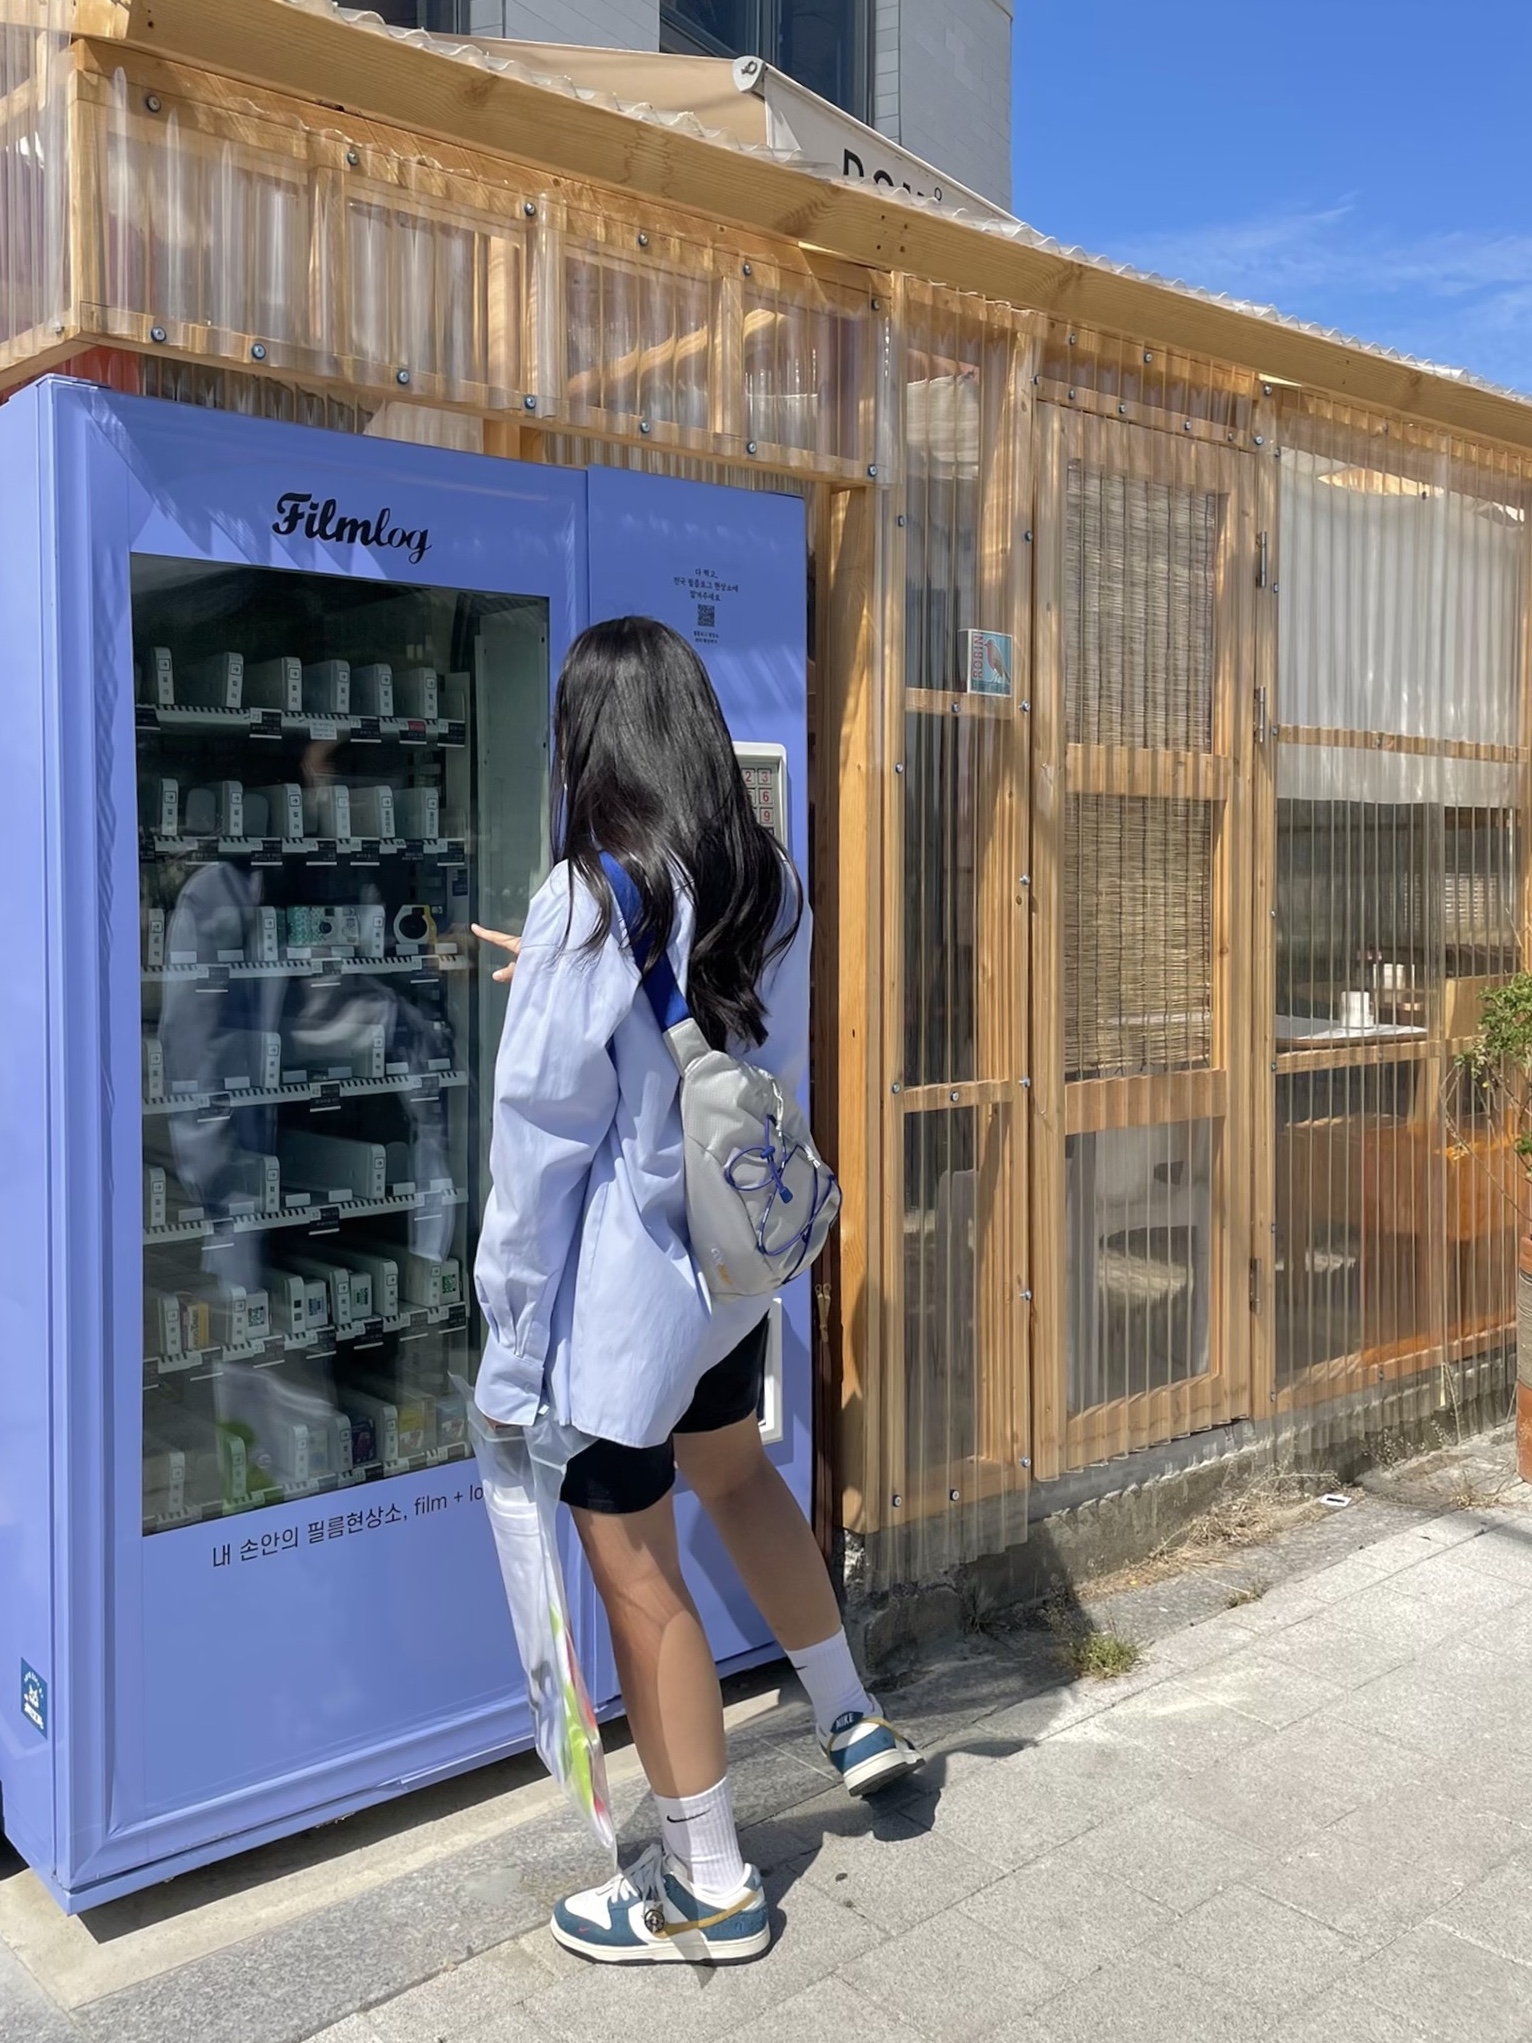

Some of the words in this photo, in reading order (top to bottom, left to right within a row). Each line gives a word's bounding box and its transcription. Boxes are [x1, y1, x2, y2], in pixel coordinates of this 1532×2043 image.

[272, 492, 432, 565] Filmlog
[674, 576, 686, 586] 전국
[714, 582, 739, 593] 현상소에
[972, 634, 984, 678] ROBIN
[745, 771, 752, 783] 2
[761, 771, 769, 783] 3
[762, 790, 769, 802] 6
[763, 810, 771, 822] 9
[212, 1544, 231, 1568] 내
[240, 1526, 299, 1562] 손안의
[308, 1503, 408, 1545] 필름현상소,
[414, 1494, 447, 1516] film
[470, 1484, 484, 1501] lo
[836, 1712, 854, 1730] NIKE
